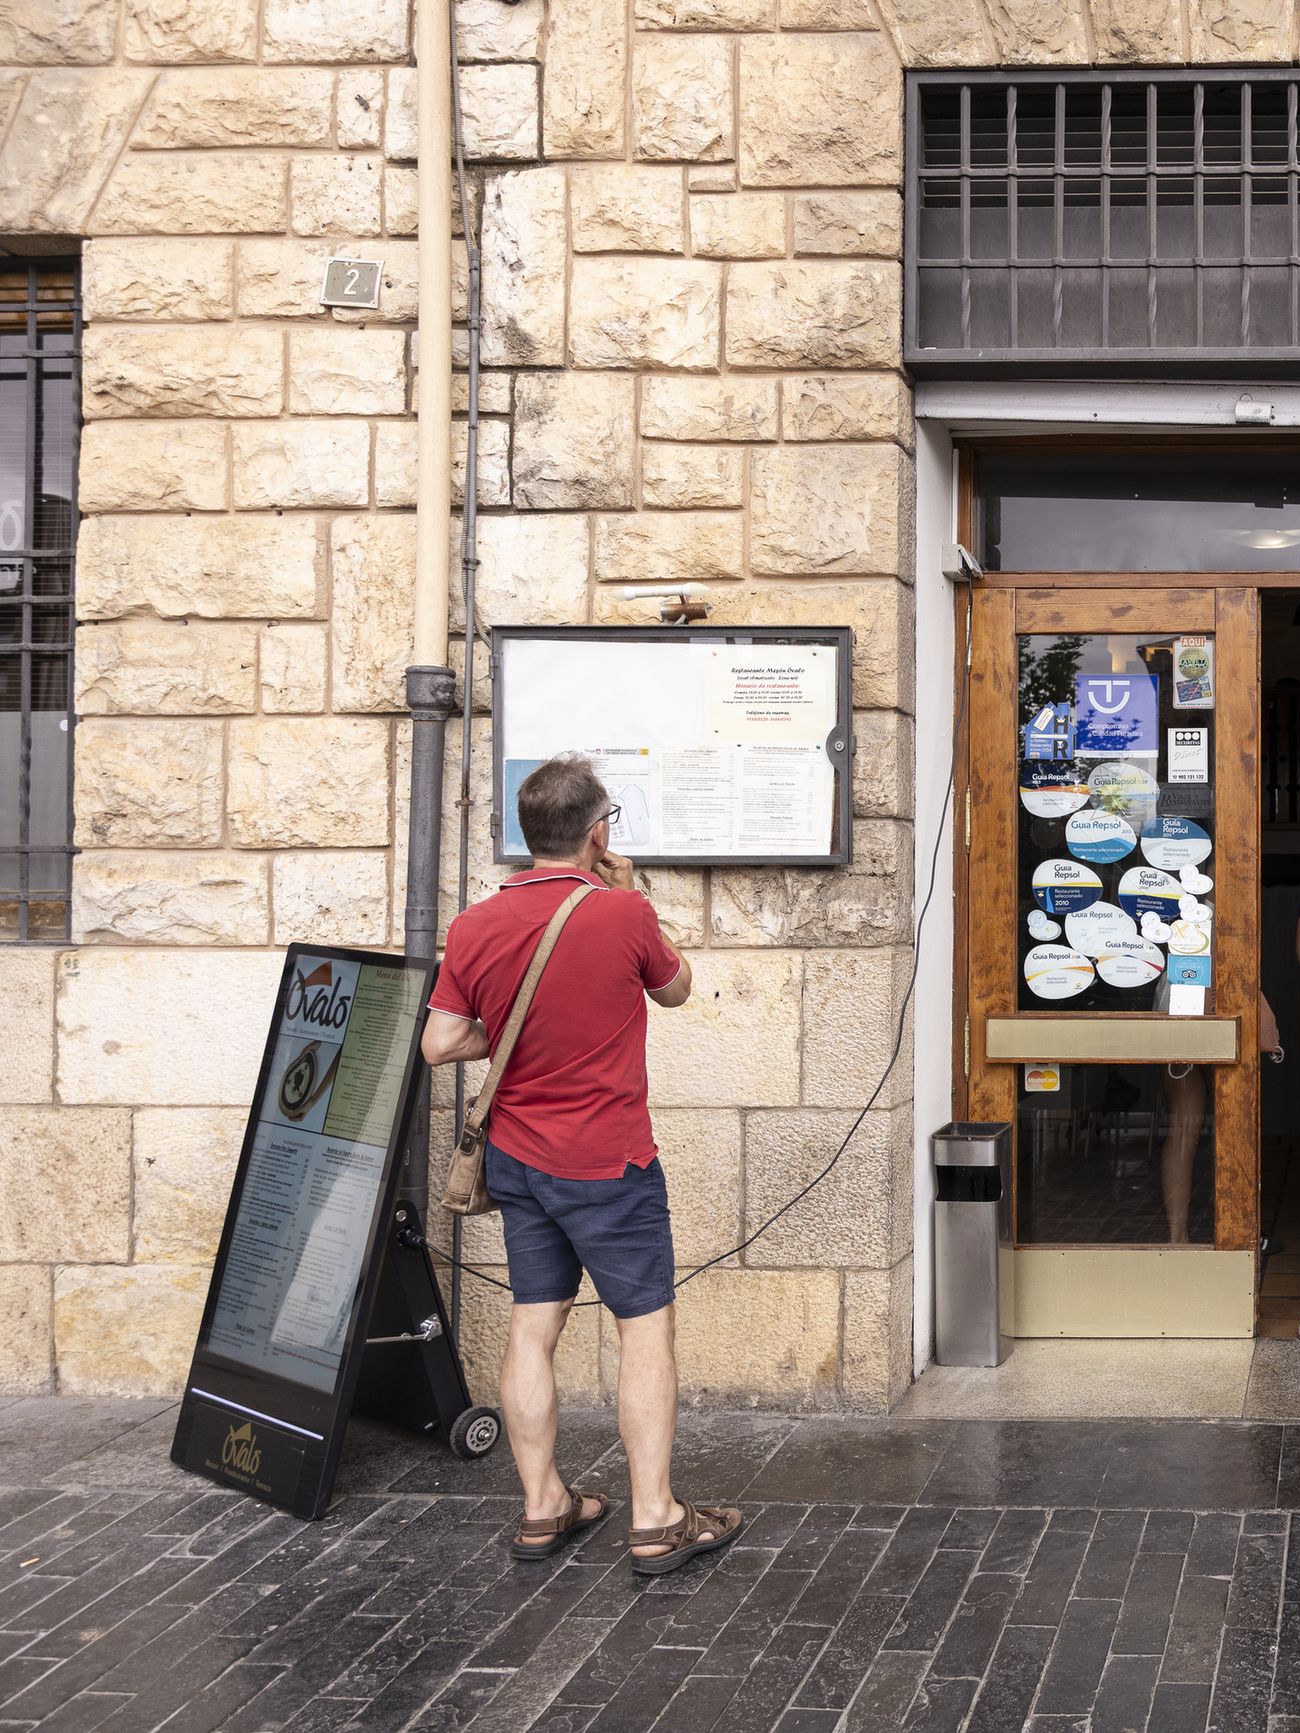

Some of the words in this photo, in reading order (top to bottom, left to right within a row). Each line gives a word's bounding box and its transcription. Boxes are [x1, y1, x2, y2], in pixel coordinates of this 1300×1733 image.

[344, 269, 360, 295] 2
[1182, 638, 1204, 646] AQUI
[1048, 773, 1070, 782] Repsol
[1112, 777, 1136, 786] Repsol
[1092, 820, 1121, 830] Repsol
[1162, 826, 1189, 834] Repsol
[1054, 871, 1080, 880] Repsol
[1139, 878, 1165, 887] Repsol
[1089, 911, 1113, 920] Repsol
[1122, 941, 1144, 950] Repsol
